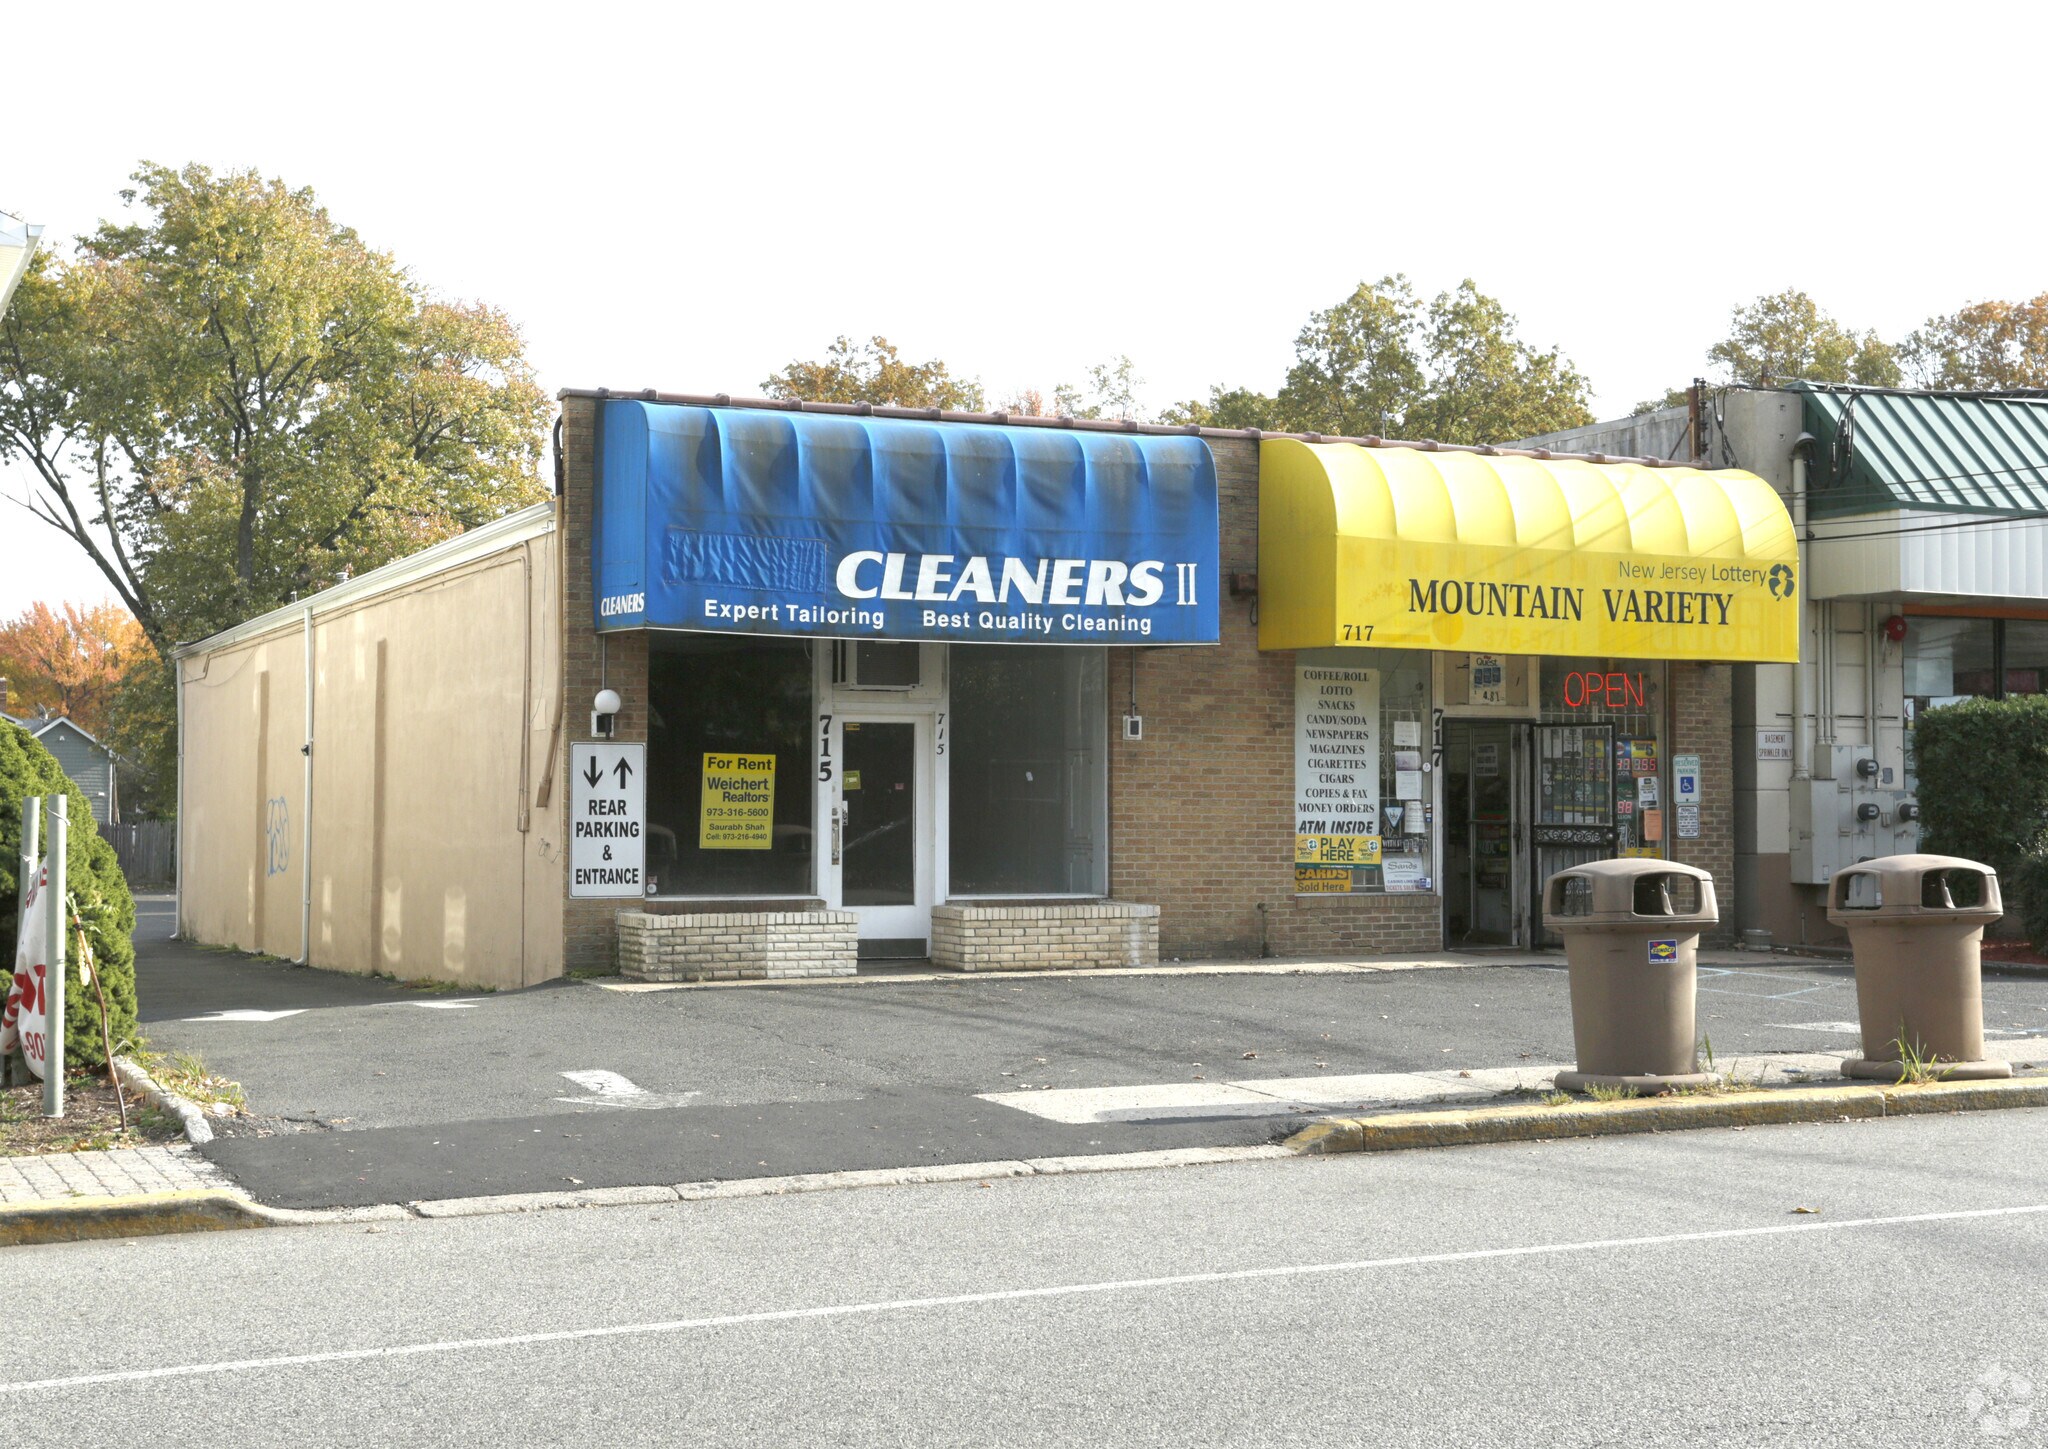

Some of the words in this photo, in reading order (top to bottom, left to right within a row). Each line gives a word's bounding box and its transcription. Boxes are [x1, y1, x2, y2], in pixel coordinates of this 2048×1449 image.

[836, 550, 1165, 606] CLEANERS
[1176, 563, 1198, 606] II
[1618, 561, 1656, 579] New
[1659, 562, 1707, 584] Jersey
[1711, 564, 1768, 587] Lottery
[600, 592, 645, 617] CLEANERS
[1408, 578, 1584, 622] MOUNTAIN
[1602, 588, 1734, 625] VARIETY
[704, 599, 779, 622] Expert
[786, 604, 885, 630] Tailoring
[922, 609, 970, 629] Best
[978, 611, 1053, 634] Quality
[1061, 613, 1152, 635] Cleaning
[1343, 624, 1375, 641] 717
[1303, 669, 1370, 682] COFFEE/ROLL
[1320, 685, 1353, 696] LOTTO
[1564, 671, 1644, 707] OPEN
[1317, 700, 1356, 711] SNACKS
[1306, 714, 1368, 726] CANDY/SODA
[936, 713, 946, 755] 715
[1306, 729, 1369, 740] NEWSPAPERS
[1432, 708, 1444, 768] 717
[1764, 734, 1786, 744] BASEMENT
[818, 714, 832, 782] 715
[1309, 743, 1366, 755] MAGAZINES
[707, 756, 733, 769] For
[737, 757, 772, 771] Rent
[1307, 758, 1367, 770] CIGARETTES
[1675, 759, 1699, 767] RESERVED
[1677, 767, 1698, 775] PARKING
[1319, 773, 1355, 784] CIGARS
[1305, 787, 1341, 799] COPIES
[1342, 788, 1350, 799] &
[1352, 788, 1368, 799] FAX
[588, 799, 627, 816] REAR
[706, 807, 769, 817] 973-316-5600
[1298, 802, 1333, 814] MONEY
[1335, 803, 1375, 814] ORDERS
[575, 821, 640, 838] PARKING
[708, 823, 743, 832] Saurabh
[745, 823, 765, 832] Shah
[1298, 820, 1326, 835] ATM
[1330, 820, 1374, 835] INSIDE
[705, 832, 721, 841] Cell:
[722, 833, 768, 842] 973-216-4940
[1320, 837, 1355, 850] PLAY
[602, 844, 613, 861] &
[1320, 849, 1355, 862] HERE
[1387, 861, 1418, 871] Sands
[575, 867, 639, 885] ENTRANCE
[1295, 868, 1349, 880] CARDS
[1297, 882, 1320, 892] Sold
[1322, 882, 1345, 892] Here
